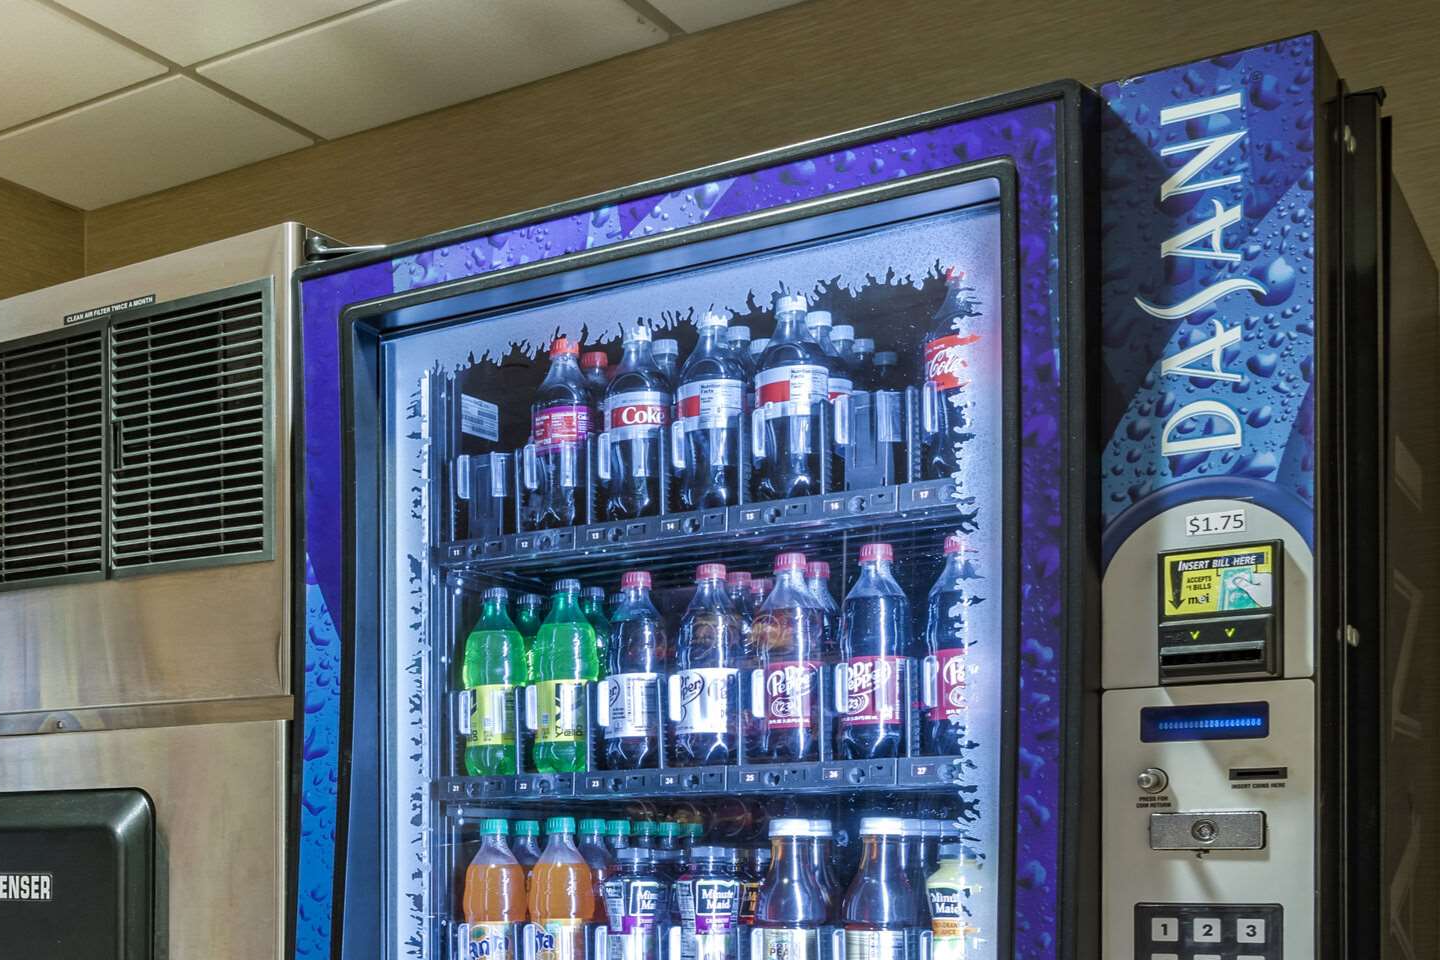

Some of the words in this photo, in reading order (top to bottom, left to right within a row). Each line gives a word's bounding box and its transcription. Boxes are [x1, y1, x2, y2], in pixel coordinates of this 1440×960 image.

[1134, 92, 1268, 457] DASANI
[67, 313, 83, 323] CLEAN
[94, 307, 110, 316] FILTER
[112, 303, 128, 311] TWICE
[133, 296, 152, 306] MONTH
[622, 406, 664, 424] Coke
[1189, 514, 1244, 534] $1.75
[1178, 558, 1210, 571] INSERT
[1212, 558, 1230, 567] BILL
[1234, 556, 1256, 565] HERE
[519, 782, 528, 790] 22
[1161, 924, 1168, 935] 1
[1202, 924, 1213, 936] 2
[1245, 925, 1257, 937] 3
